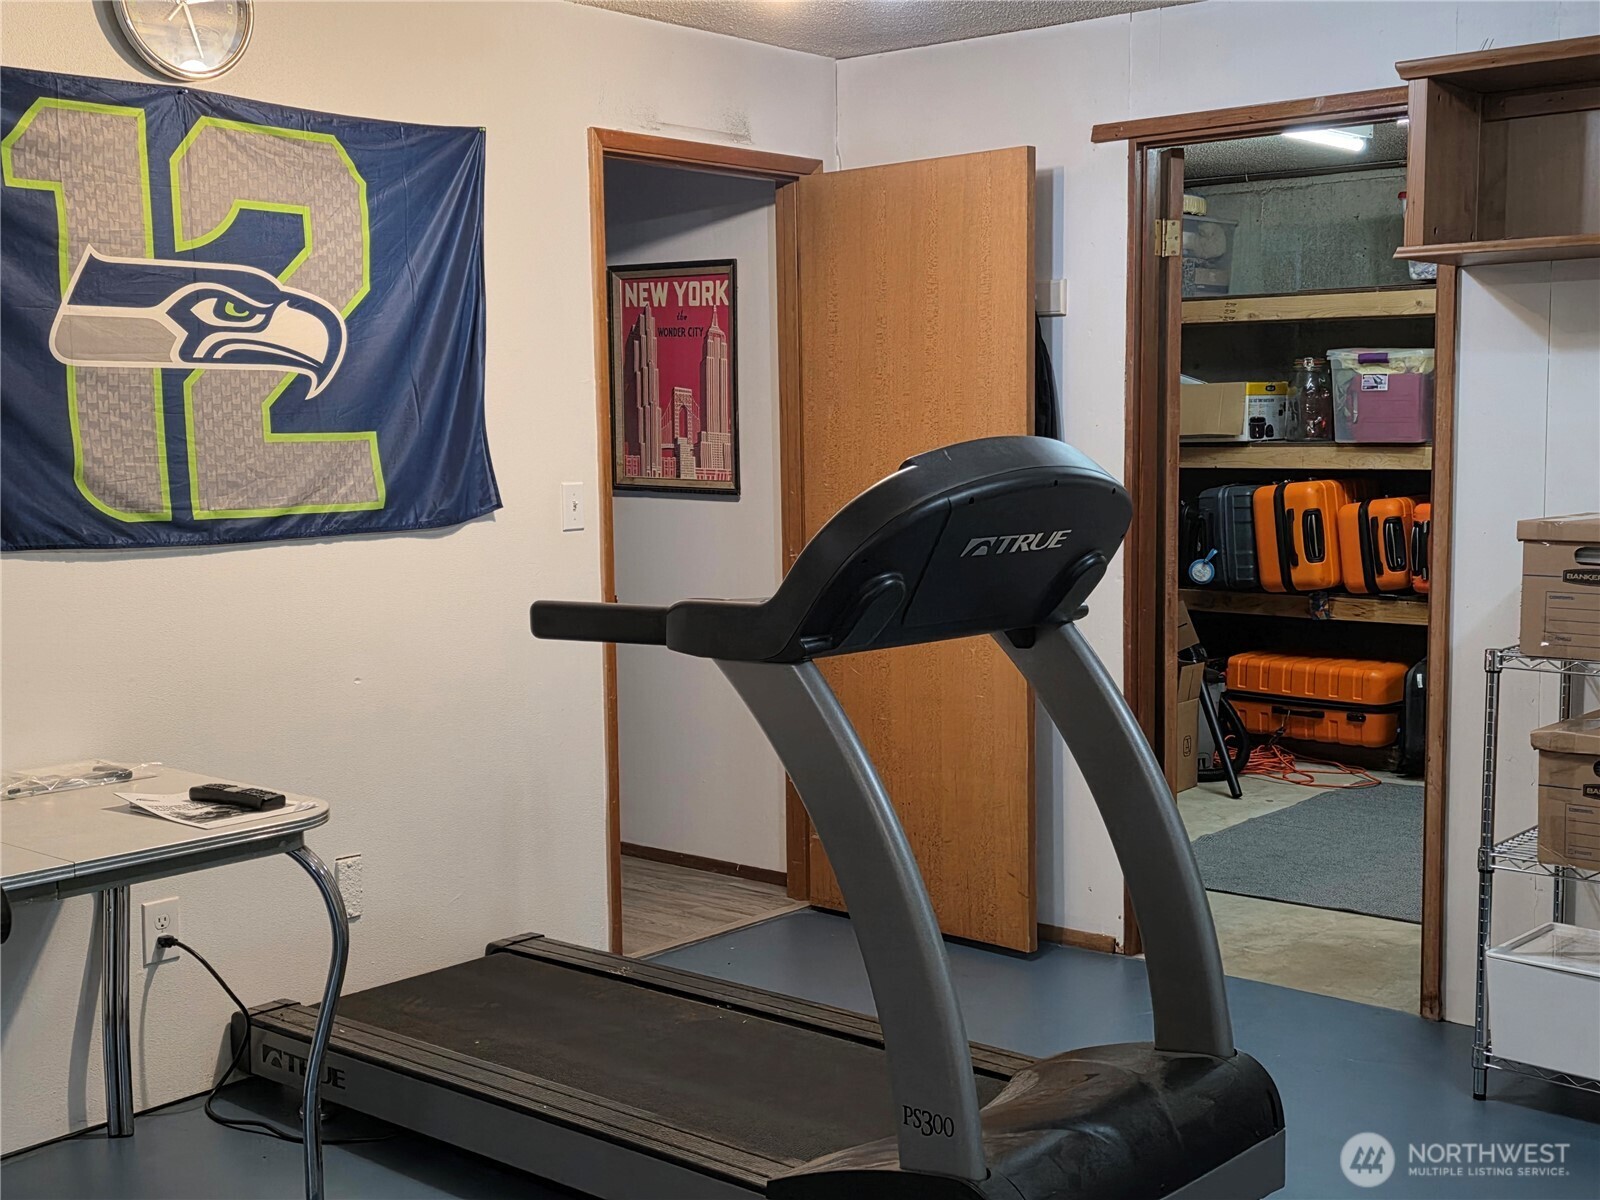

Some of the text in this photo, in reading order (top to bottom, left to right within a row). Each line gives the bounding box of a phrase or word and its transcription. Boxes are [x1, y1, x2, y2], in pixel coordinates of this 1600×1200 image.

[625, 280, 729, 307] NEW YORK
[1, 97, 386, 523] 12
[676, 310, 688, 321] the
[657, 326, 704, 338] WONDER CITY
[996, 529, 1072, 554] TRUE
[902, 1104, 954, 1138] PS300
